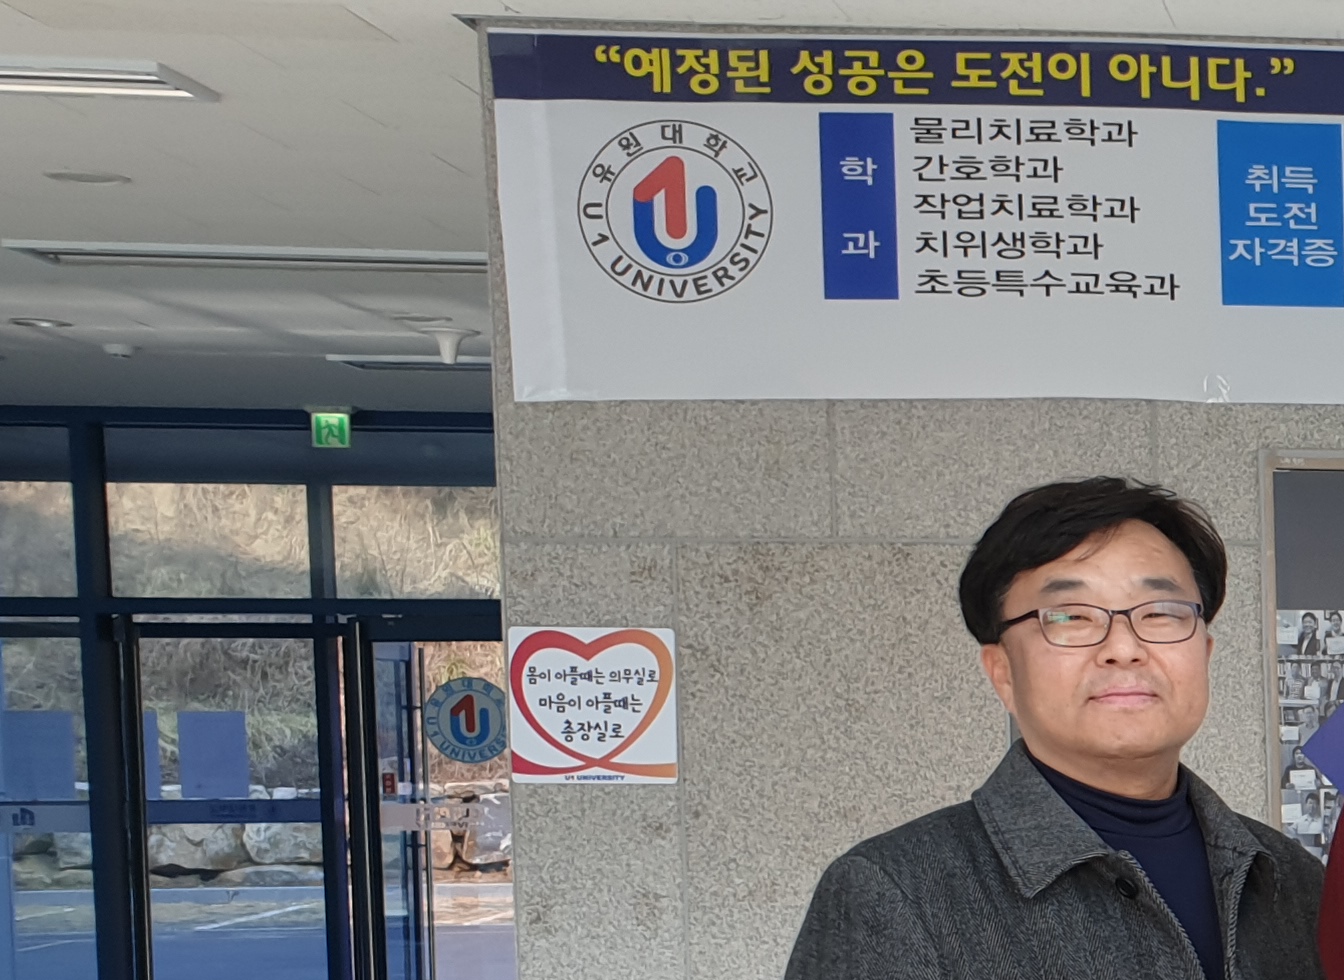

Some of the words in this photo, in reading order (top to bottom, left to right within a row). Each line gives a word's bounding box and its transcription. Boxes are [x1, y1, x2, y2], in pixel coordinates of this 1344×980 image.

[789, 46, 936, 98] 성공은
[951, 52, 1090, 97] 도전이
[910, 117, 1137, 147] 물리치료학과
[592, 123, 758, 186] 유원대학교
[913, 155, 1063, 183] 간호학과
[1245, 165, 1317, 194] 취득
[914, 193, 1140, 223] 작업치료학과
[1246, 203, 1317, 229] 도전
[610, 202, 768, 298] UNIVERSITY
[916, 231, 1103, 260] 치위생학과
[1229, 238, 1337, 266] 자격증
[915, 269, 1180, 300] 초등특수교육과
[526, 665, 551, 685] 몸이
[554, 665, 605, 686] 아플때는
[609, 667, 659, 686] 의무실로
[539, 692, 581, 713] 마음이
[586, 692, 643, 714] 아플때는
[561, 719, 625, 742] 총장실로
